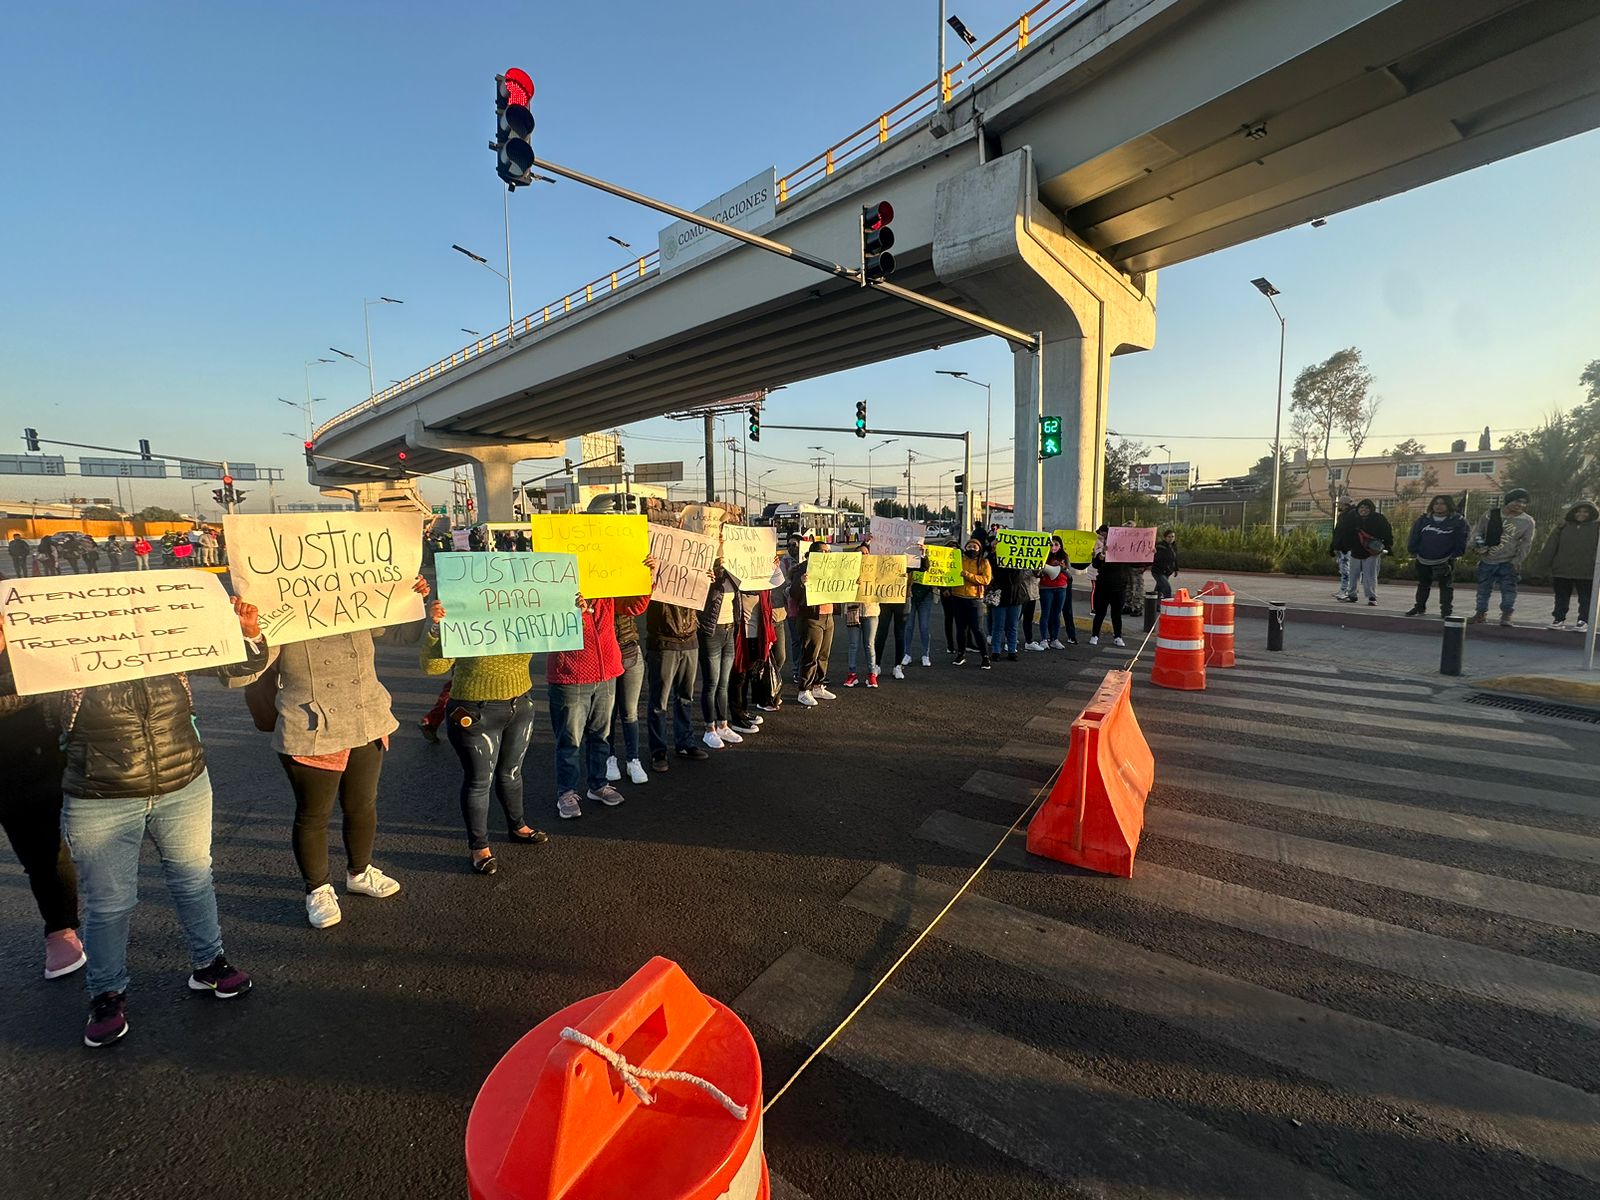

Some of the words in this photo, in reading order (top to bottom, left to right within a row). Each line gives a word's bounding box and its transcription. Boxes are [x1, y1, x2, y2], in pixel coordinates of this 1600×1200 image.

[678, 188, 768, 245] COMUCACIONES
[1044, 420, 1058, 433] 62
[540, 515, 634, 540] Justicia
[724, 526, 761, 541] JUSTICIA
[998, 533, 1053, 547] JUSTICIA
[1009, 546, 1042, 558] PARA
[678, 538, 715, 572] PARA
[998, 556, 1045, 570] KARINA
[447, 555, 577, 584] JUSTICIA
[861, 562, 874, 573] iss
[277, 572, 341, 601] para
[350, 566, 403, 588] miss
[656, 561, 703, 601] KARI
[5, 586, 145, 605] ATENCION
[156, 583, 204, 592] DEL
[479, 588, 541, 612] PARA
[7, 604, 162, 626] PRESIDENTE
[168, 602, 204, 611] DEL
[258, 603, 294, 629] sticia
[304, 584, 396, 629] KARY
[9, 631, 145, 650] TRIBUNAL
[151, 627, 189, 637] DE
[442, 620, 498, 647] MISS
[503, 612, 579, 642] KARINA
